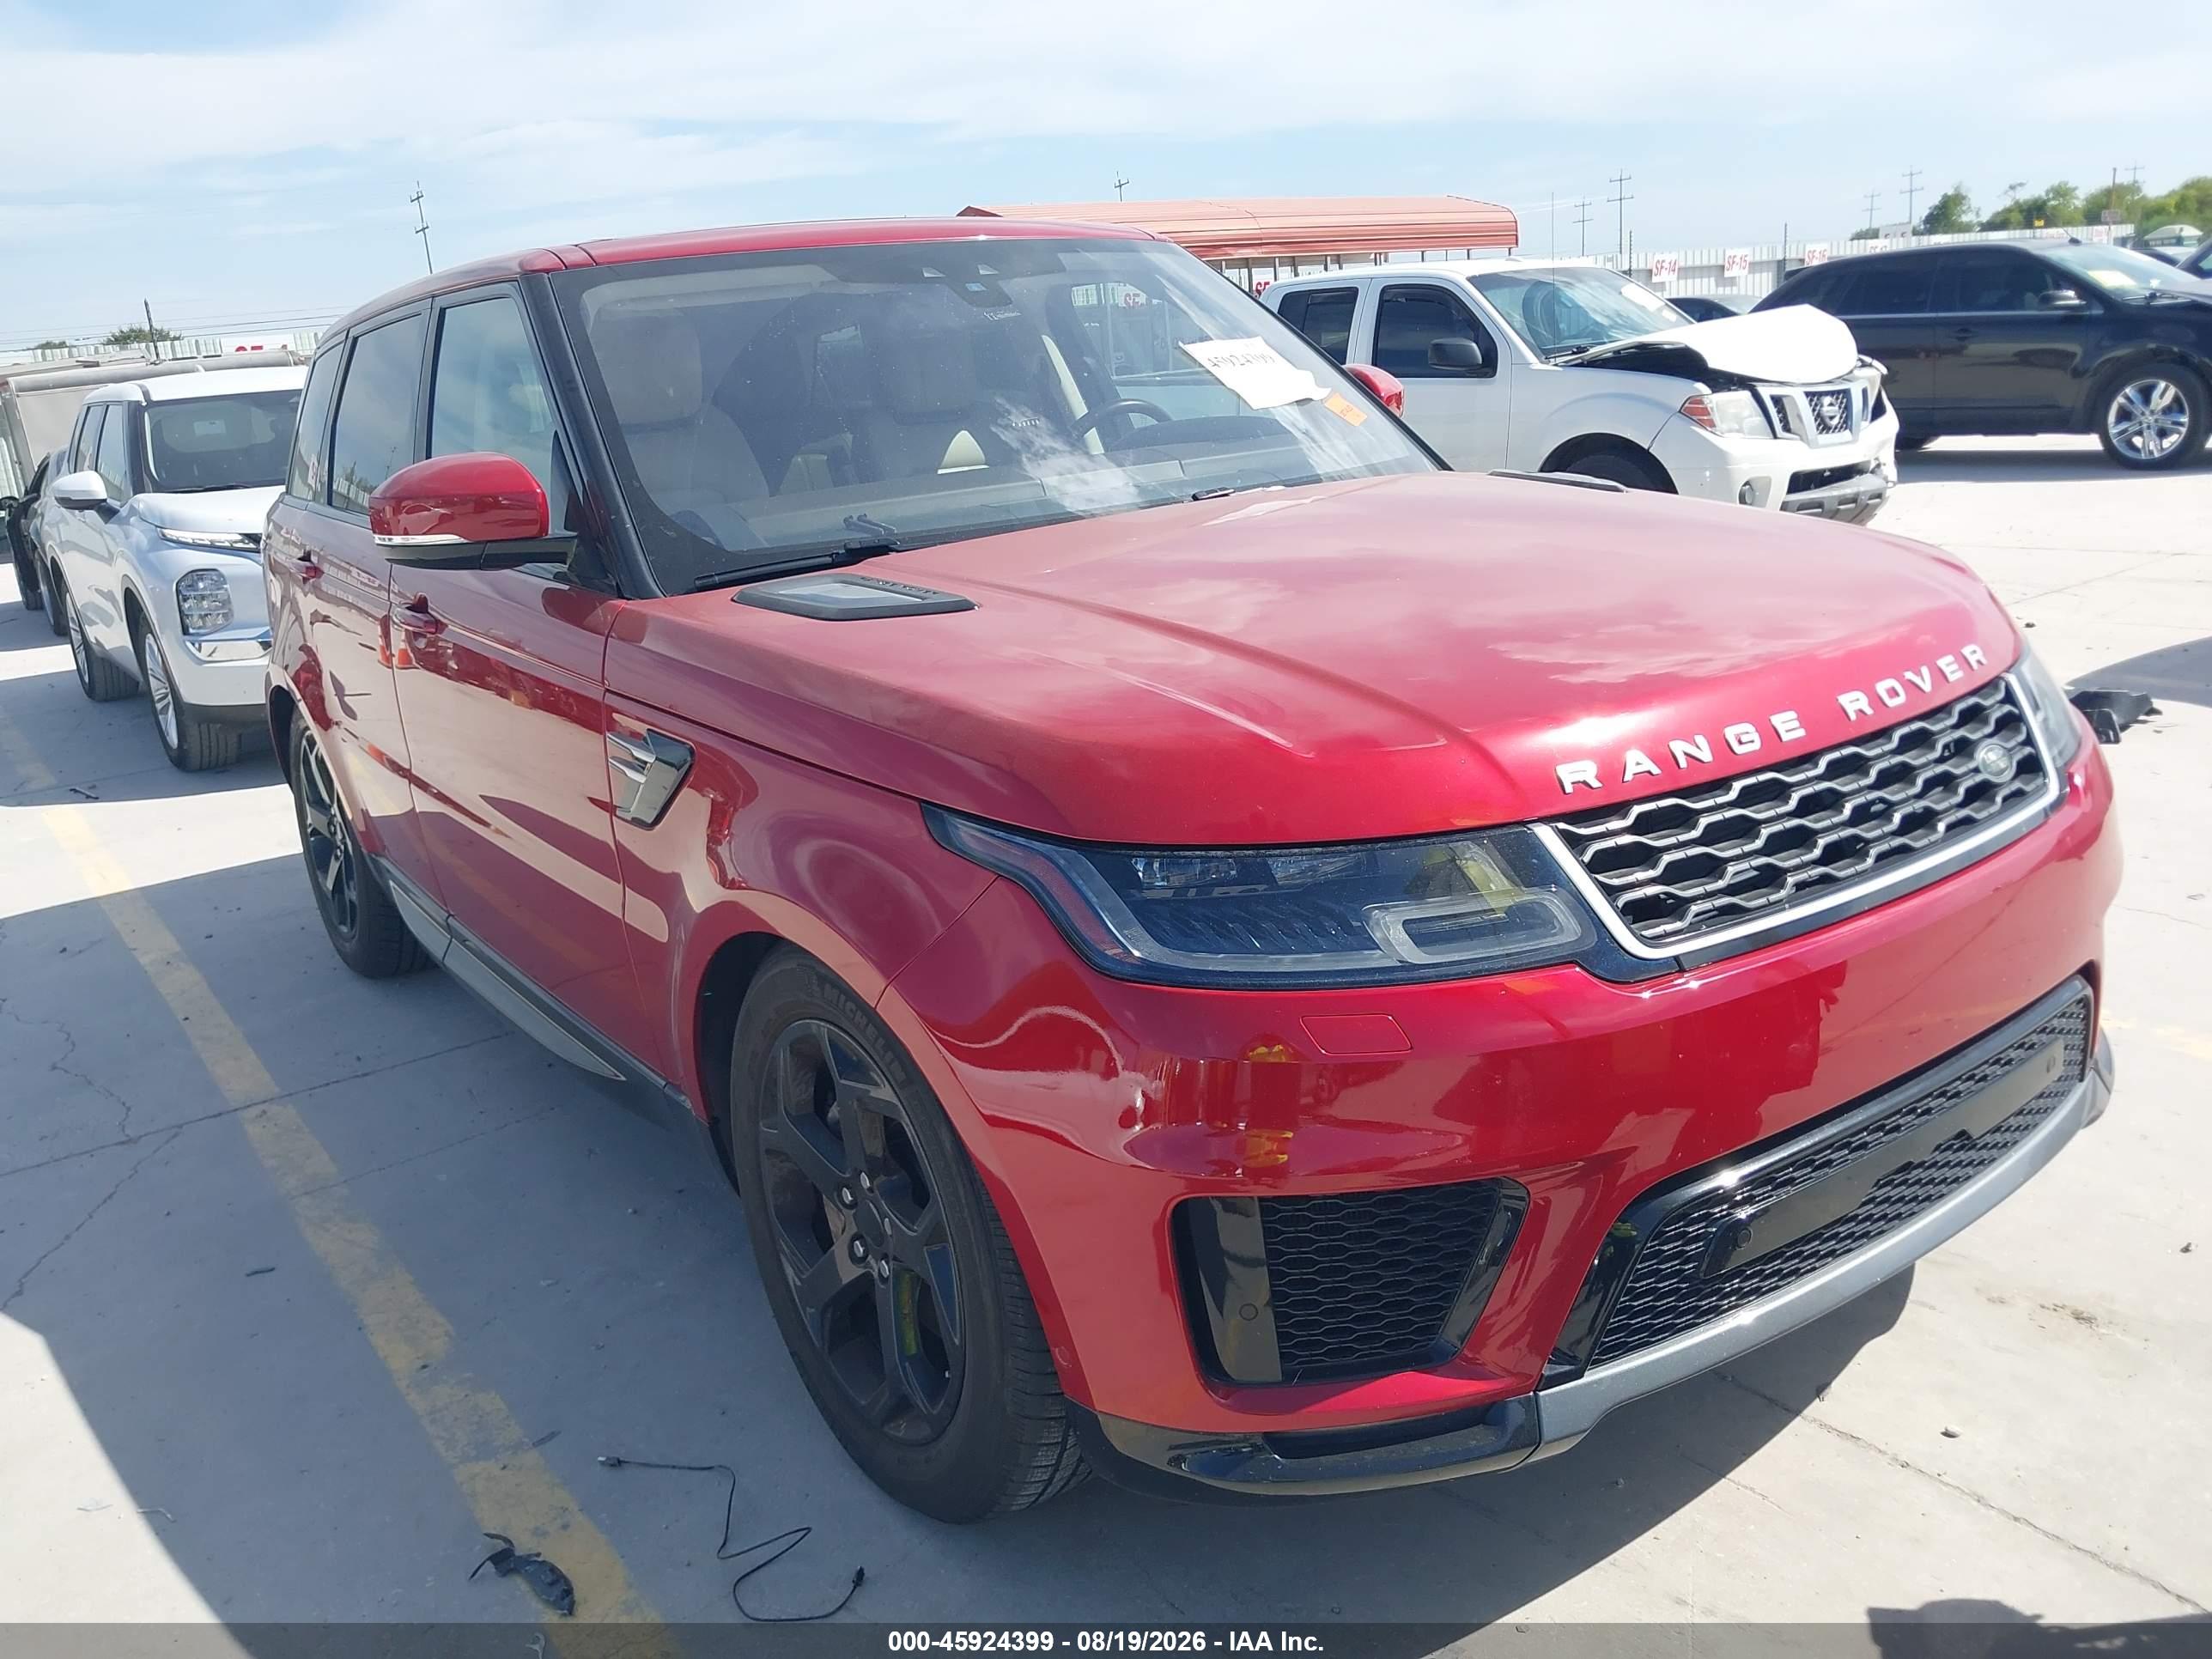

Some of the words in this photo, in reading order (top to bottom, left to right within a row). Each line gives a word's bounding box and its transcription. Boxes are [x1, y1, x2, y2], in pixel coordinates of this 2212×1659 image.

[1654, 259, 1677, 276] SF-14
[1726, 254, 1748, 271] SF-15
[1555, 710, 1807, 795] RANGE
[1837, 643, 1989, 722] ROVER
[822, 984, 907, 1085] MICHELIN
